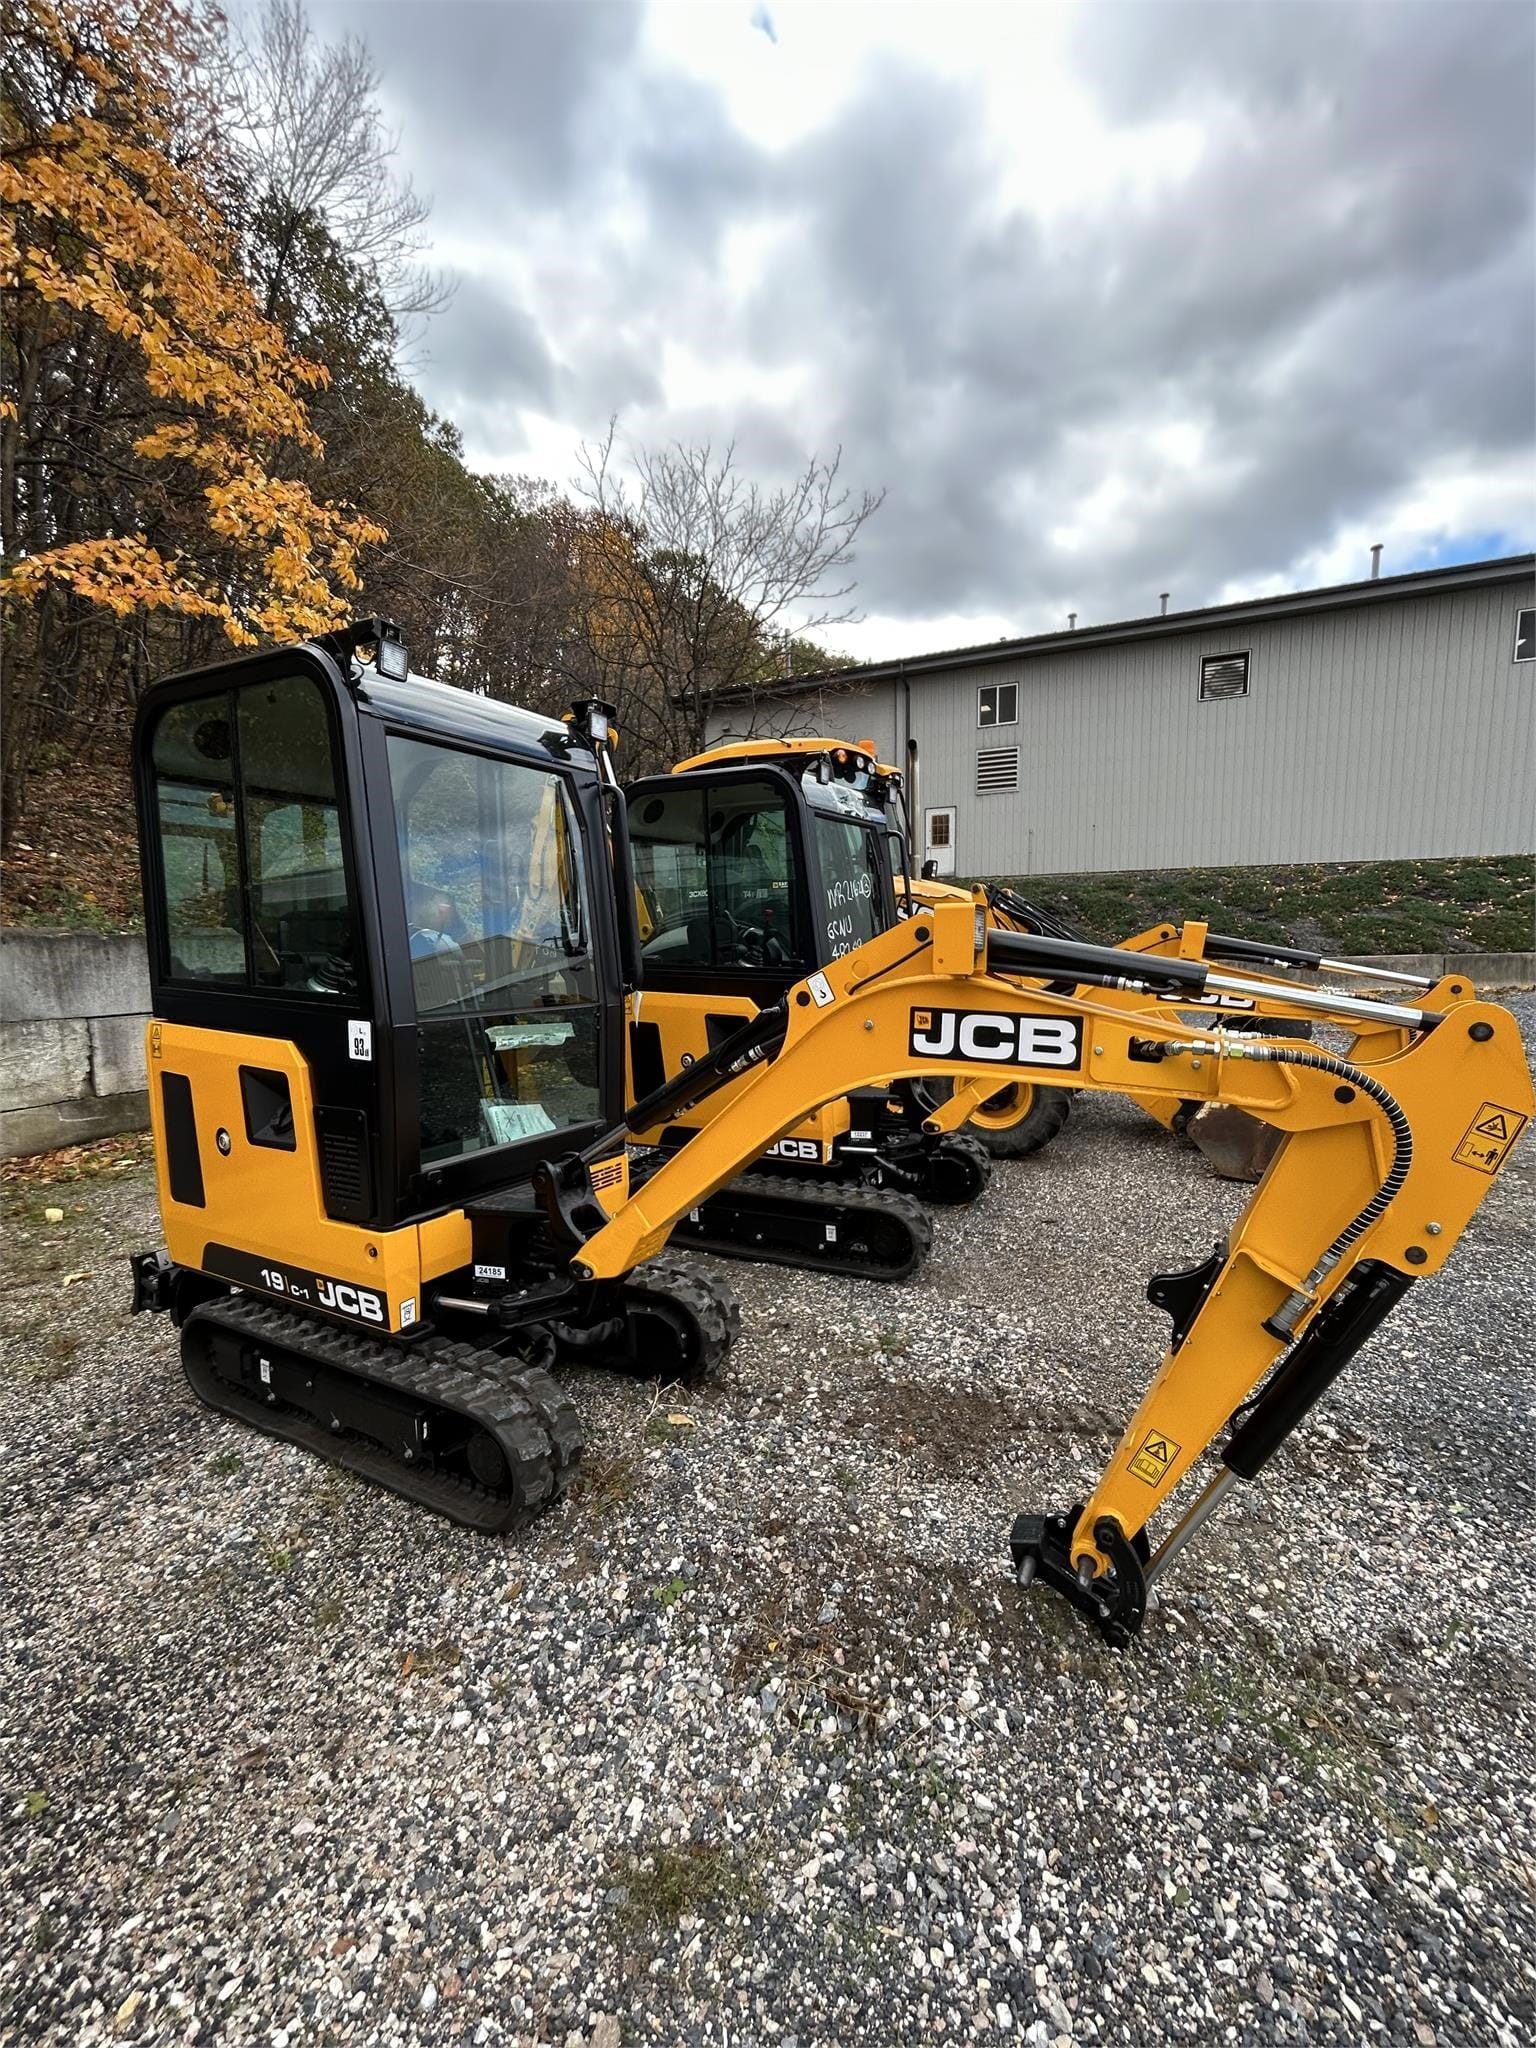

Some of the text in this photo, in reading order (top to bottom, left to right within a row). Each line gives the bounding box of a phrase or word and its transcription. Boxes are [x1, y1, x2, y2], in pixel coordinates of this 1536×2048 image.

[913, 1012, 1077, 1065] JCB
[260, 1268, 285, 1291] 19
[318, 1281, 384, 1322] JCB
[479, 1266, 502, 1276] 24185
